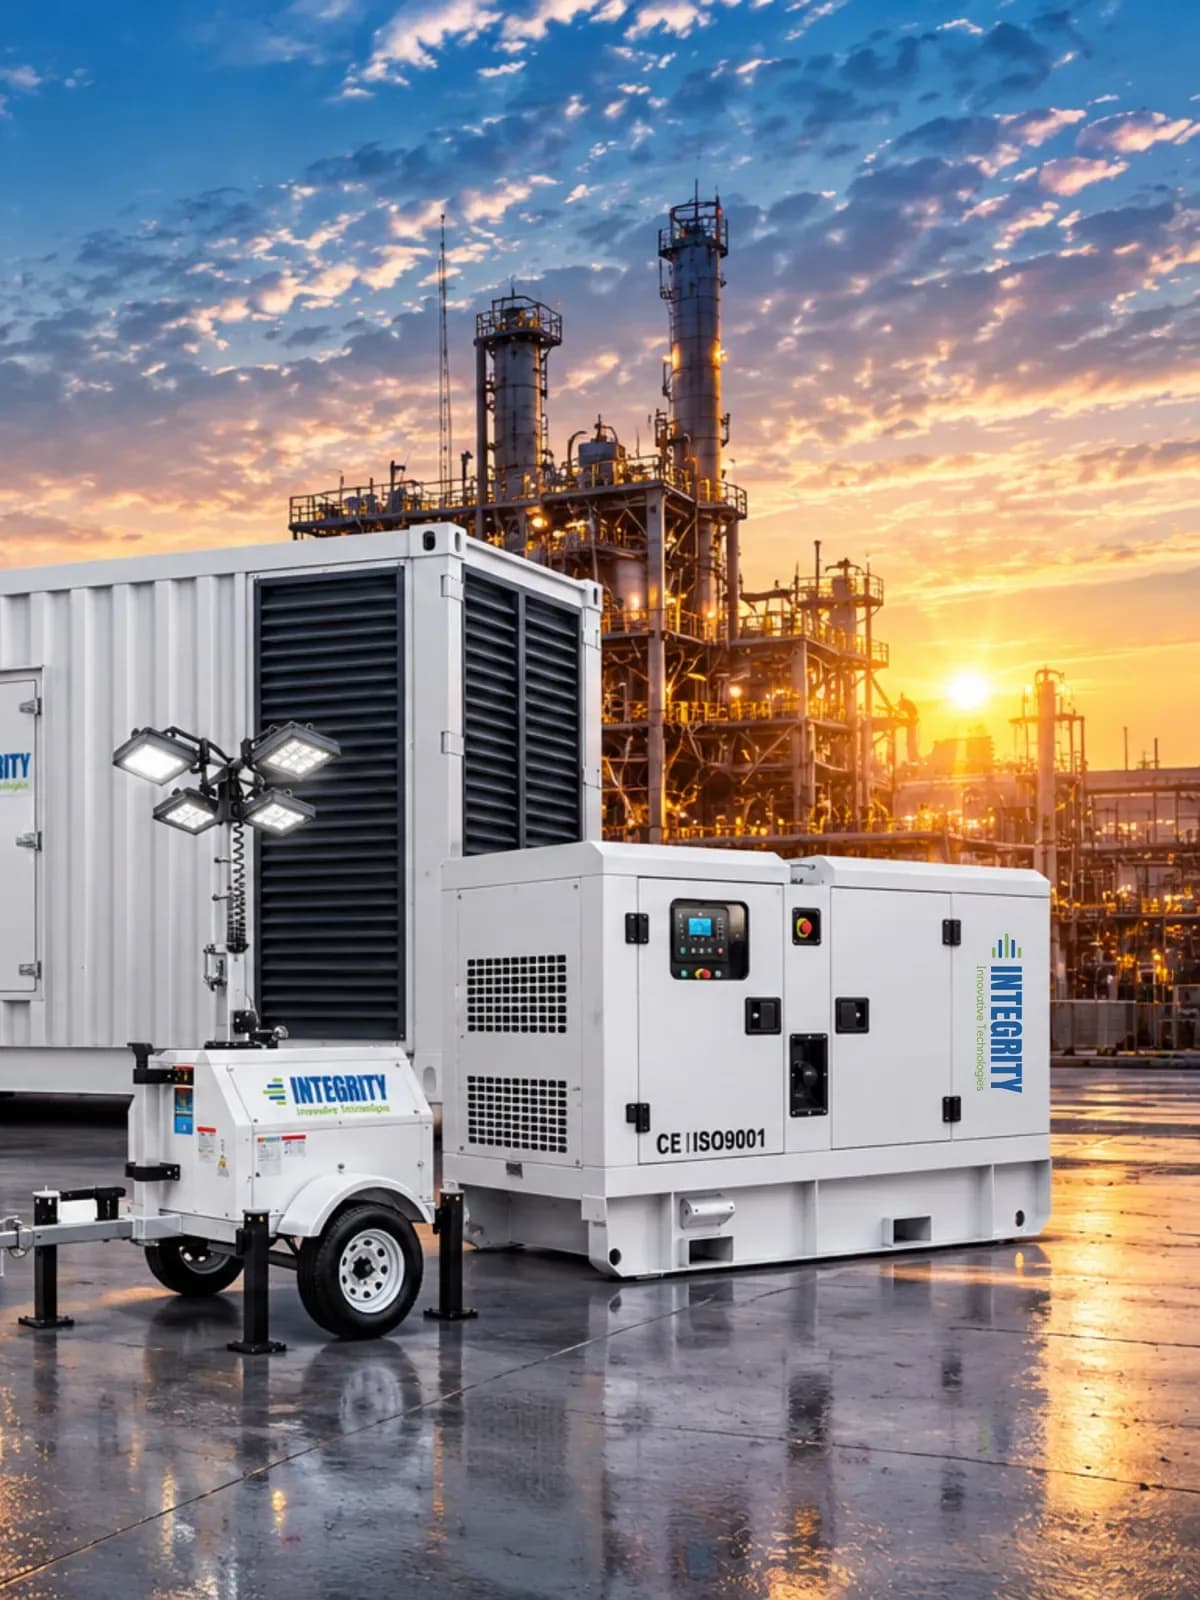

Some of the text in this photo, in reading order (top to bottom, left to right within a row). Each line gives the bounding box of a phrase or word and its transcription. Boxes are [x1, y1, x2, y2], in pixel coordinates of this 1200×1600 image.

[974, 966, 986, 1092] Innovative Technologies
[990, 966, 1023, 1093] INTEGRITY
[289, 1074, 387, 1105] INTEGRITY
[657, 1133, 681, 1155] CE
[693, 1128, 765, 1152] ISO9001
